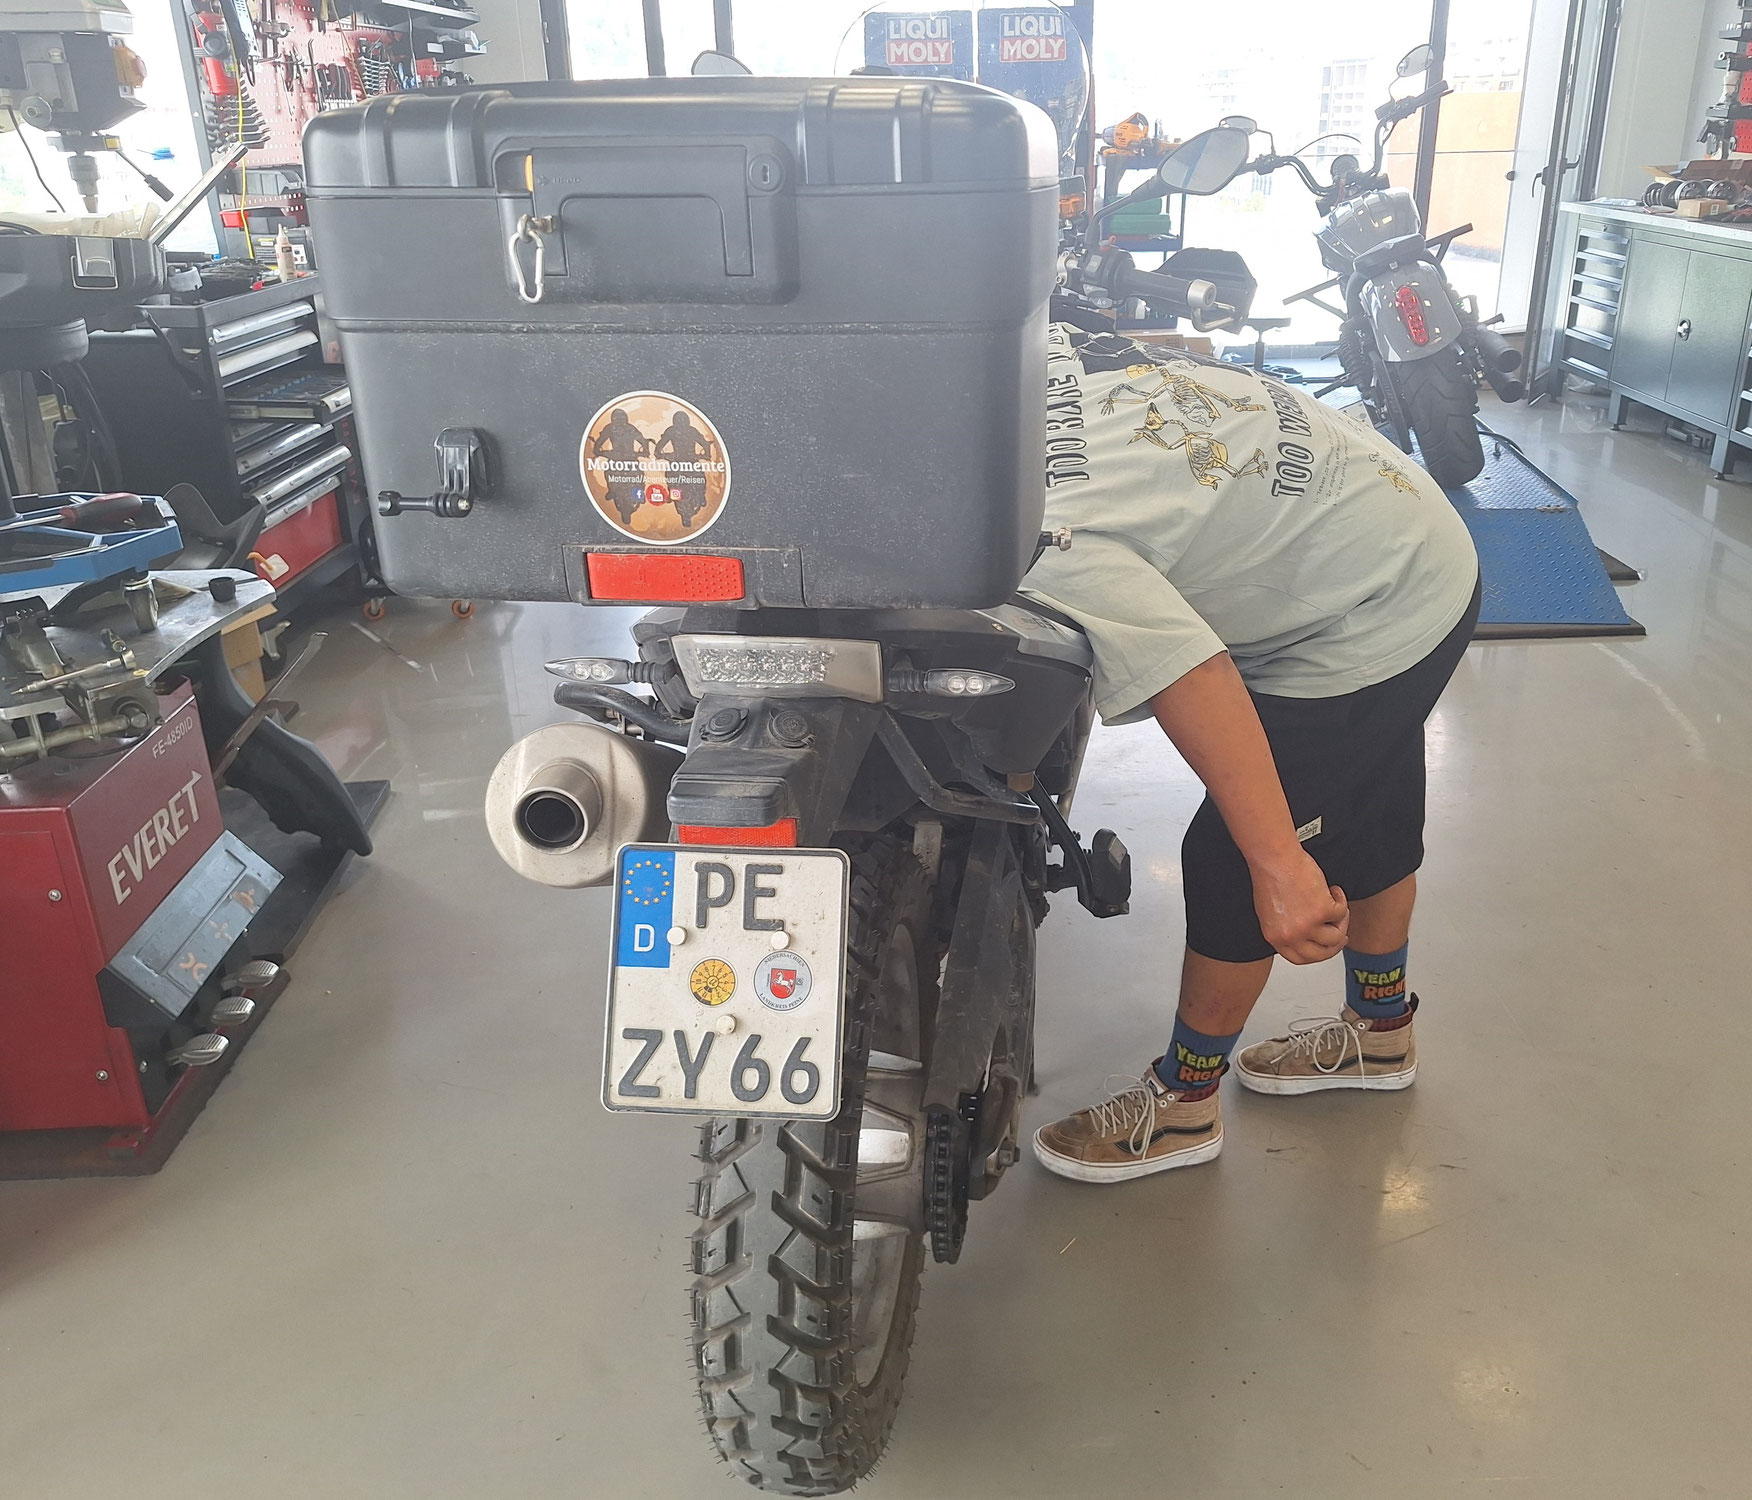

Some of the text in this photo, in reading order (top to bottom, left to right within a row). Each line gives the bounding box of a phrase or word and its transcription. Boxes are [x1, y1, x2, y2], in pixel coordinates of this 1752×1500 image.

[889, 18, 948, 40] LIQUI
[1003, 15, 1062, 37] LIQUI
[889, 42, 950, 63] MOLY
[1003, 38, 1065, 60] MOLY
[587, 458, 725, 473] Motorradmomente
[1271, 441, 1315, 498] TOO
[107, 770, 202, 906] EVERET
[694, 862, 785, 931] PE
[633, 924, 655, 952] D
[617, 1027, 820, 1104] ZY 66
